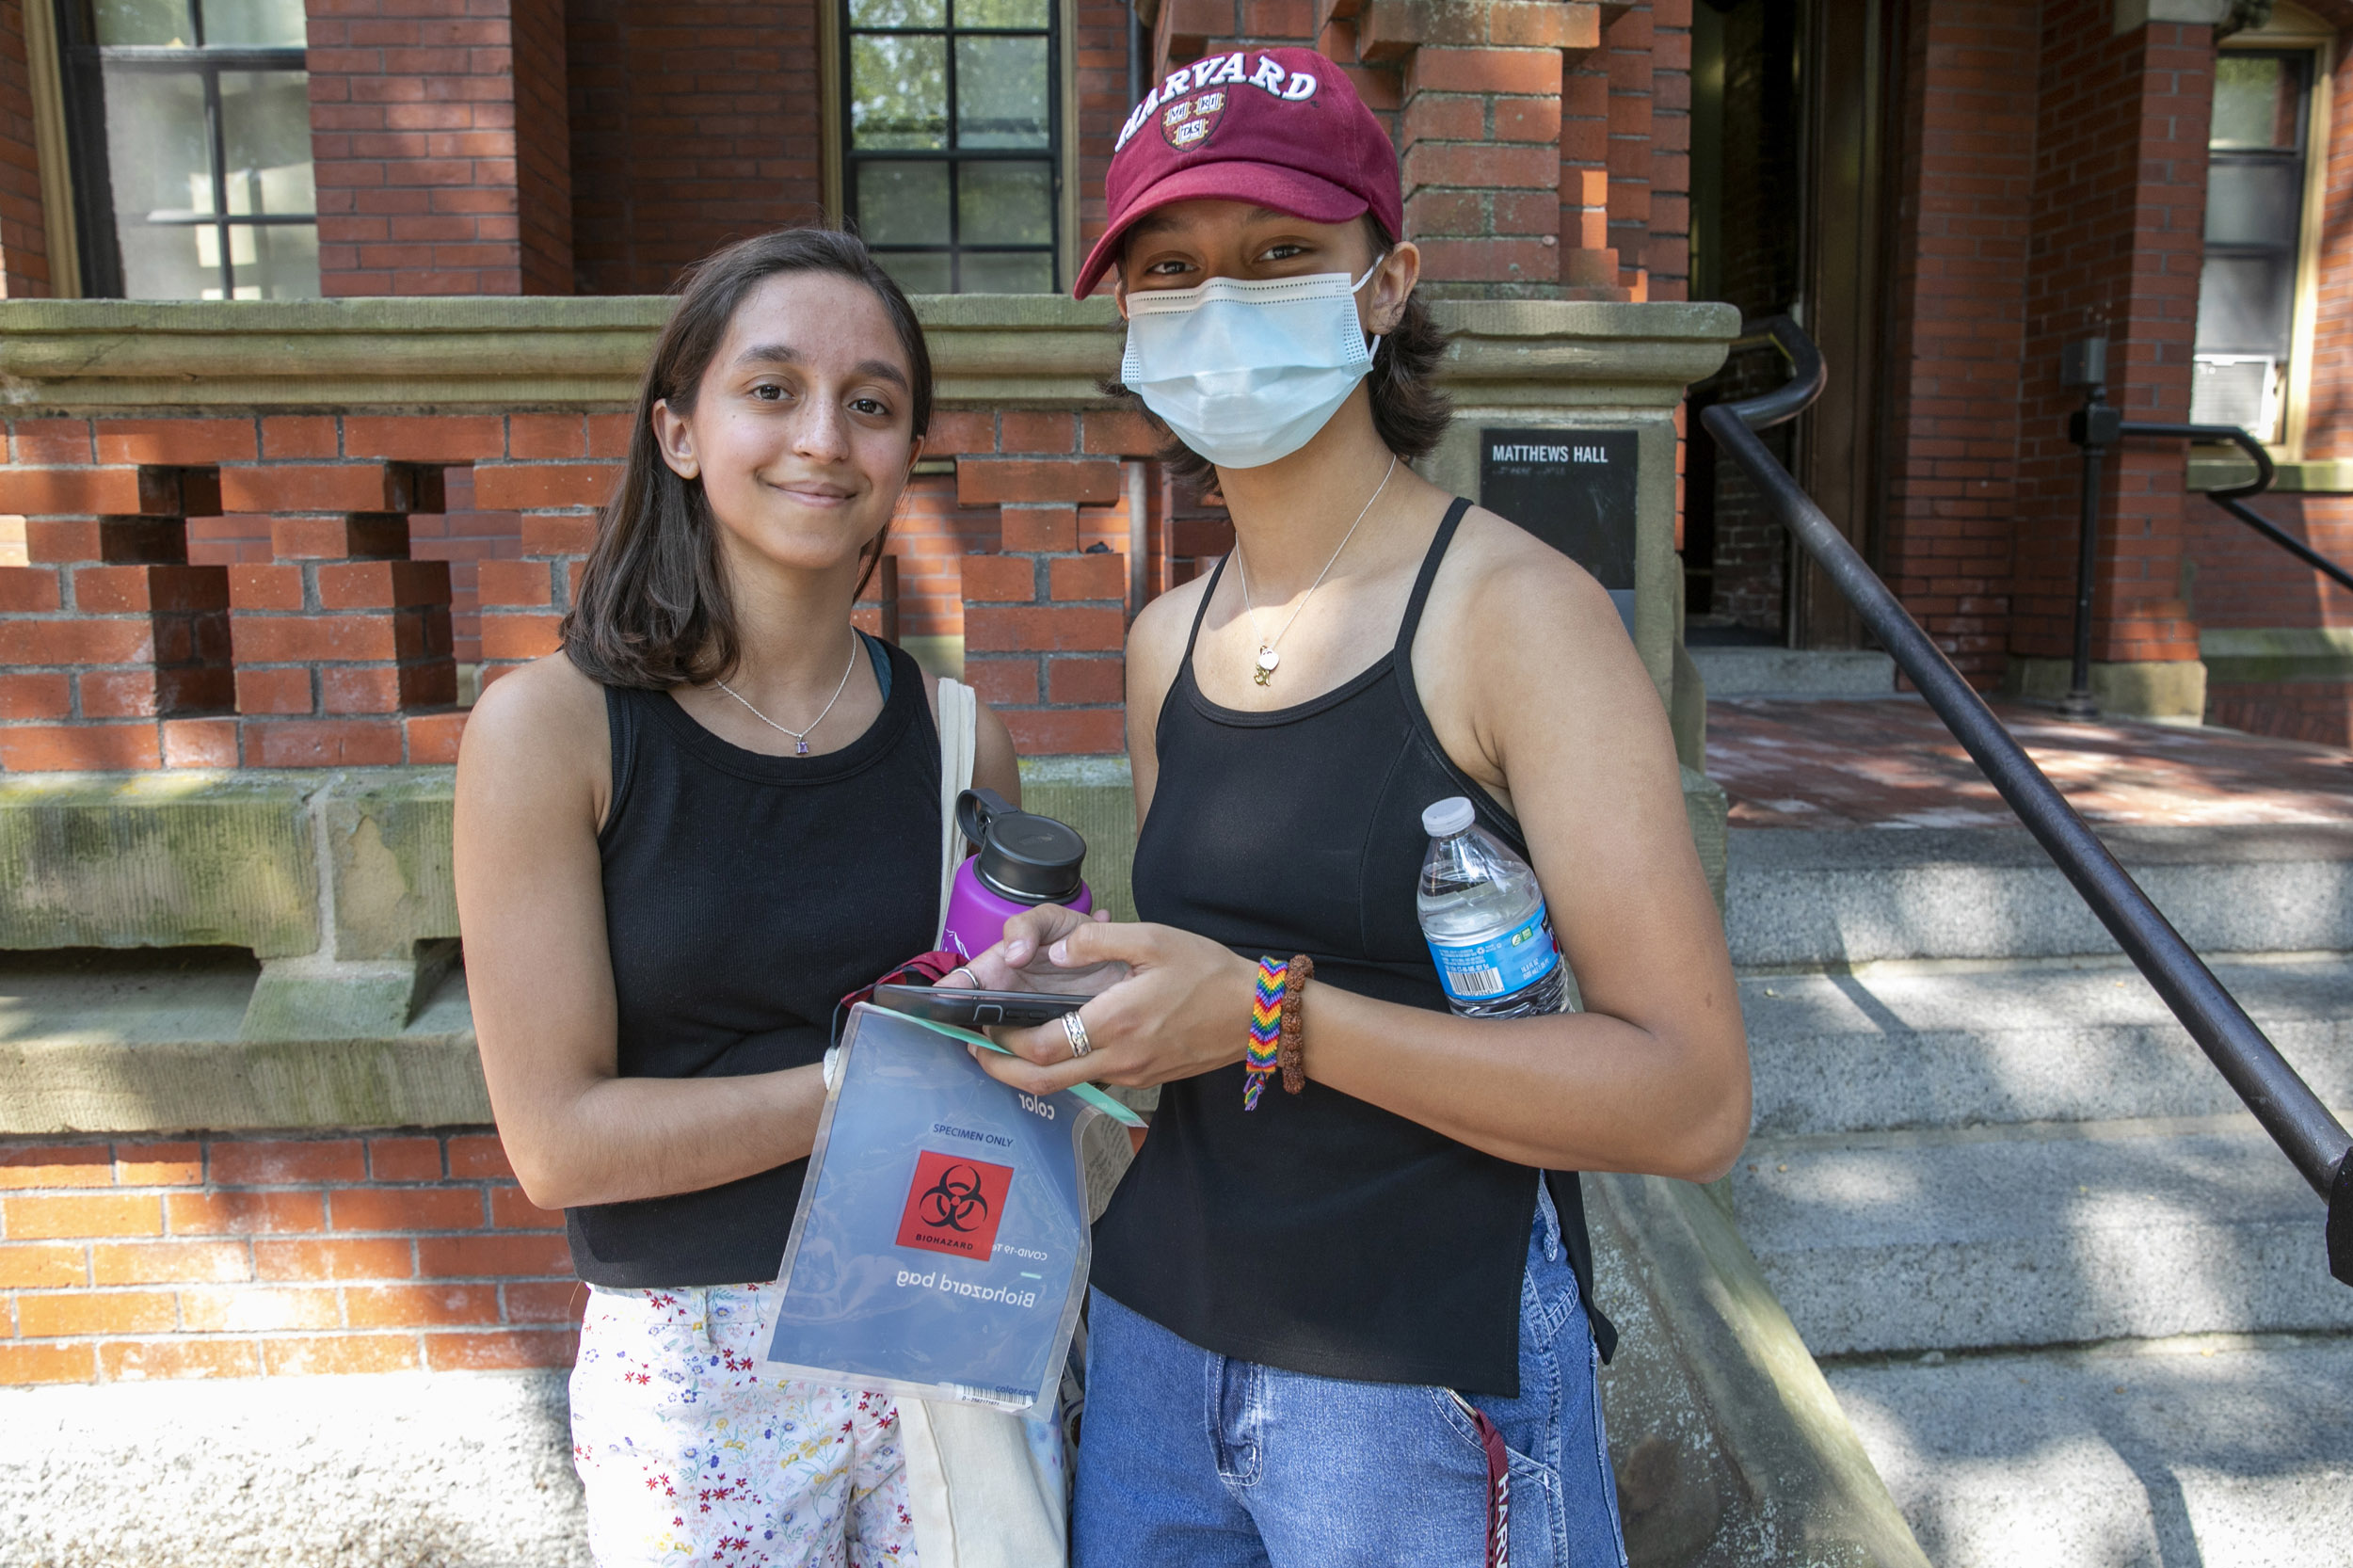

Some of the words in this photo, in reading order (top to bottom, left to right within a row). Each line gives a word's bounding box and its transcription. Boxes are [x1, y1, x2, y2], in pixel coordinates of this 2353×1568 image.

[1114, 52, 1318, 153] HARVARD
[1493, 444, 1569, 462] MATTHEWS
[1574, 445, 1609, 463] HALL
[933, 1124, 984, 1143] SPECIMEN
[985, 1134, 1014, 1148] ONLY
[916, 1233, 974, 1251] BIOHAZARD
[995, 1385, 1037, 1398] color.com
